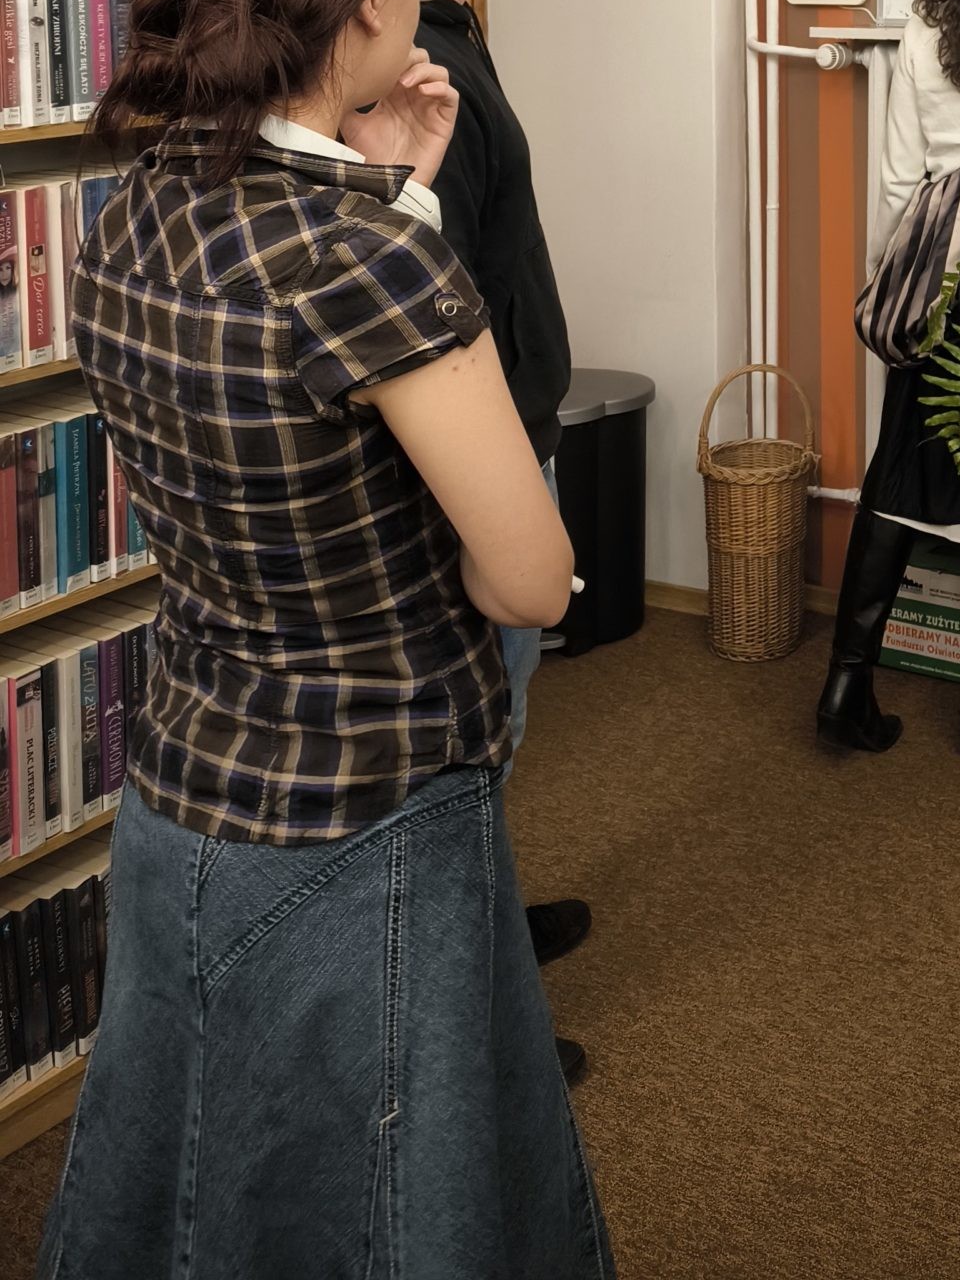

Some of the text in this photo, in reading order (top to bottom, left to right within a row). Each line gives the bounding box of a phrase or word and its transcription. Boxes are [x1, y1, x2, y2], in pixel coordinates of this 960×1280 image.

[78, 14, 87, 56] SKOŃCZY
[79, 57, 88, 72] SIĘ
[80, 72, 89, 95] LATO
[32, 277, 45, 336] Dar serca
[72, 428, 81, 460] IZABELA
[890, 608, 960, 631] ERAMY ZUŻYTE
[26, 738, 35, 764] PLAC
[107, 715, 122, 782] CEREMONIA
[27, 765, 37, 820] LITERACKI
